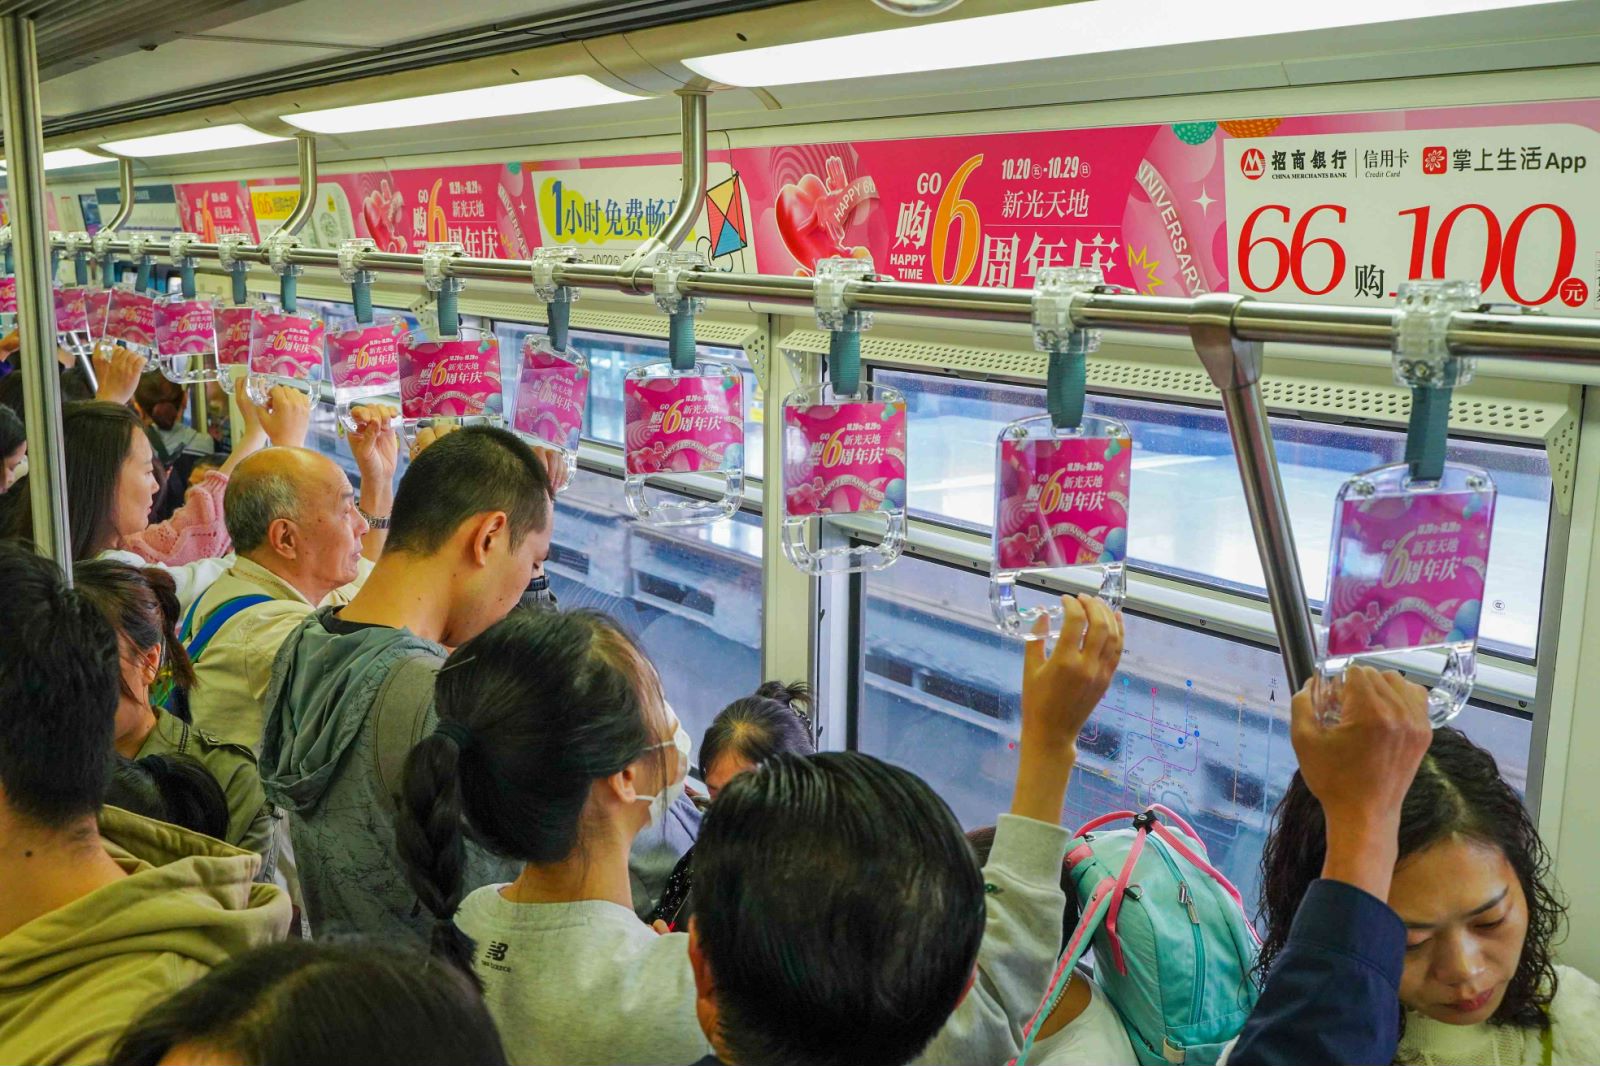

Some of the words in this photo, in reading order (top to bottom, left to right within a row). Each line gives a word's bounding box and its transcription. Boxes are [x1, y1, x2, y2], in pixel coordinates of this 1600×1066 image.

[1271, 150, 1347, 171] 招商银行
[1363, 148, 1410, 168] 信用卡
[916, 172, 942, 195] GO
[1385, 170, 1401, 178] Card
[452, 200, 485, 217] 新光天地
[834, 183, 861, 222] HAPPY
[1001, 188, 1090, 219] 新光天地
[890, 254, 926, 266] HAPPY
[1237, 204, 1347, 296] 66
[1355, 264, 1385, 299] 购
[1389, 203, 1577, 306] 100
[898, 268, 923, 281] TIME
[431, 359, 448, 387] 6
[662, 399, 684, 435] 6
[679, 416, 722, 432] 周年庆
[822, 427, 845, 468] 6
[839, 448, 885, 466] 周年庆
[1040, 467, 1066, 515] 6
[1057, 491, 1106, 512] 周年庆
[1382, 531, 1416, 589] 6
[1404, 556, 1461, 584] 周年庆
